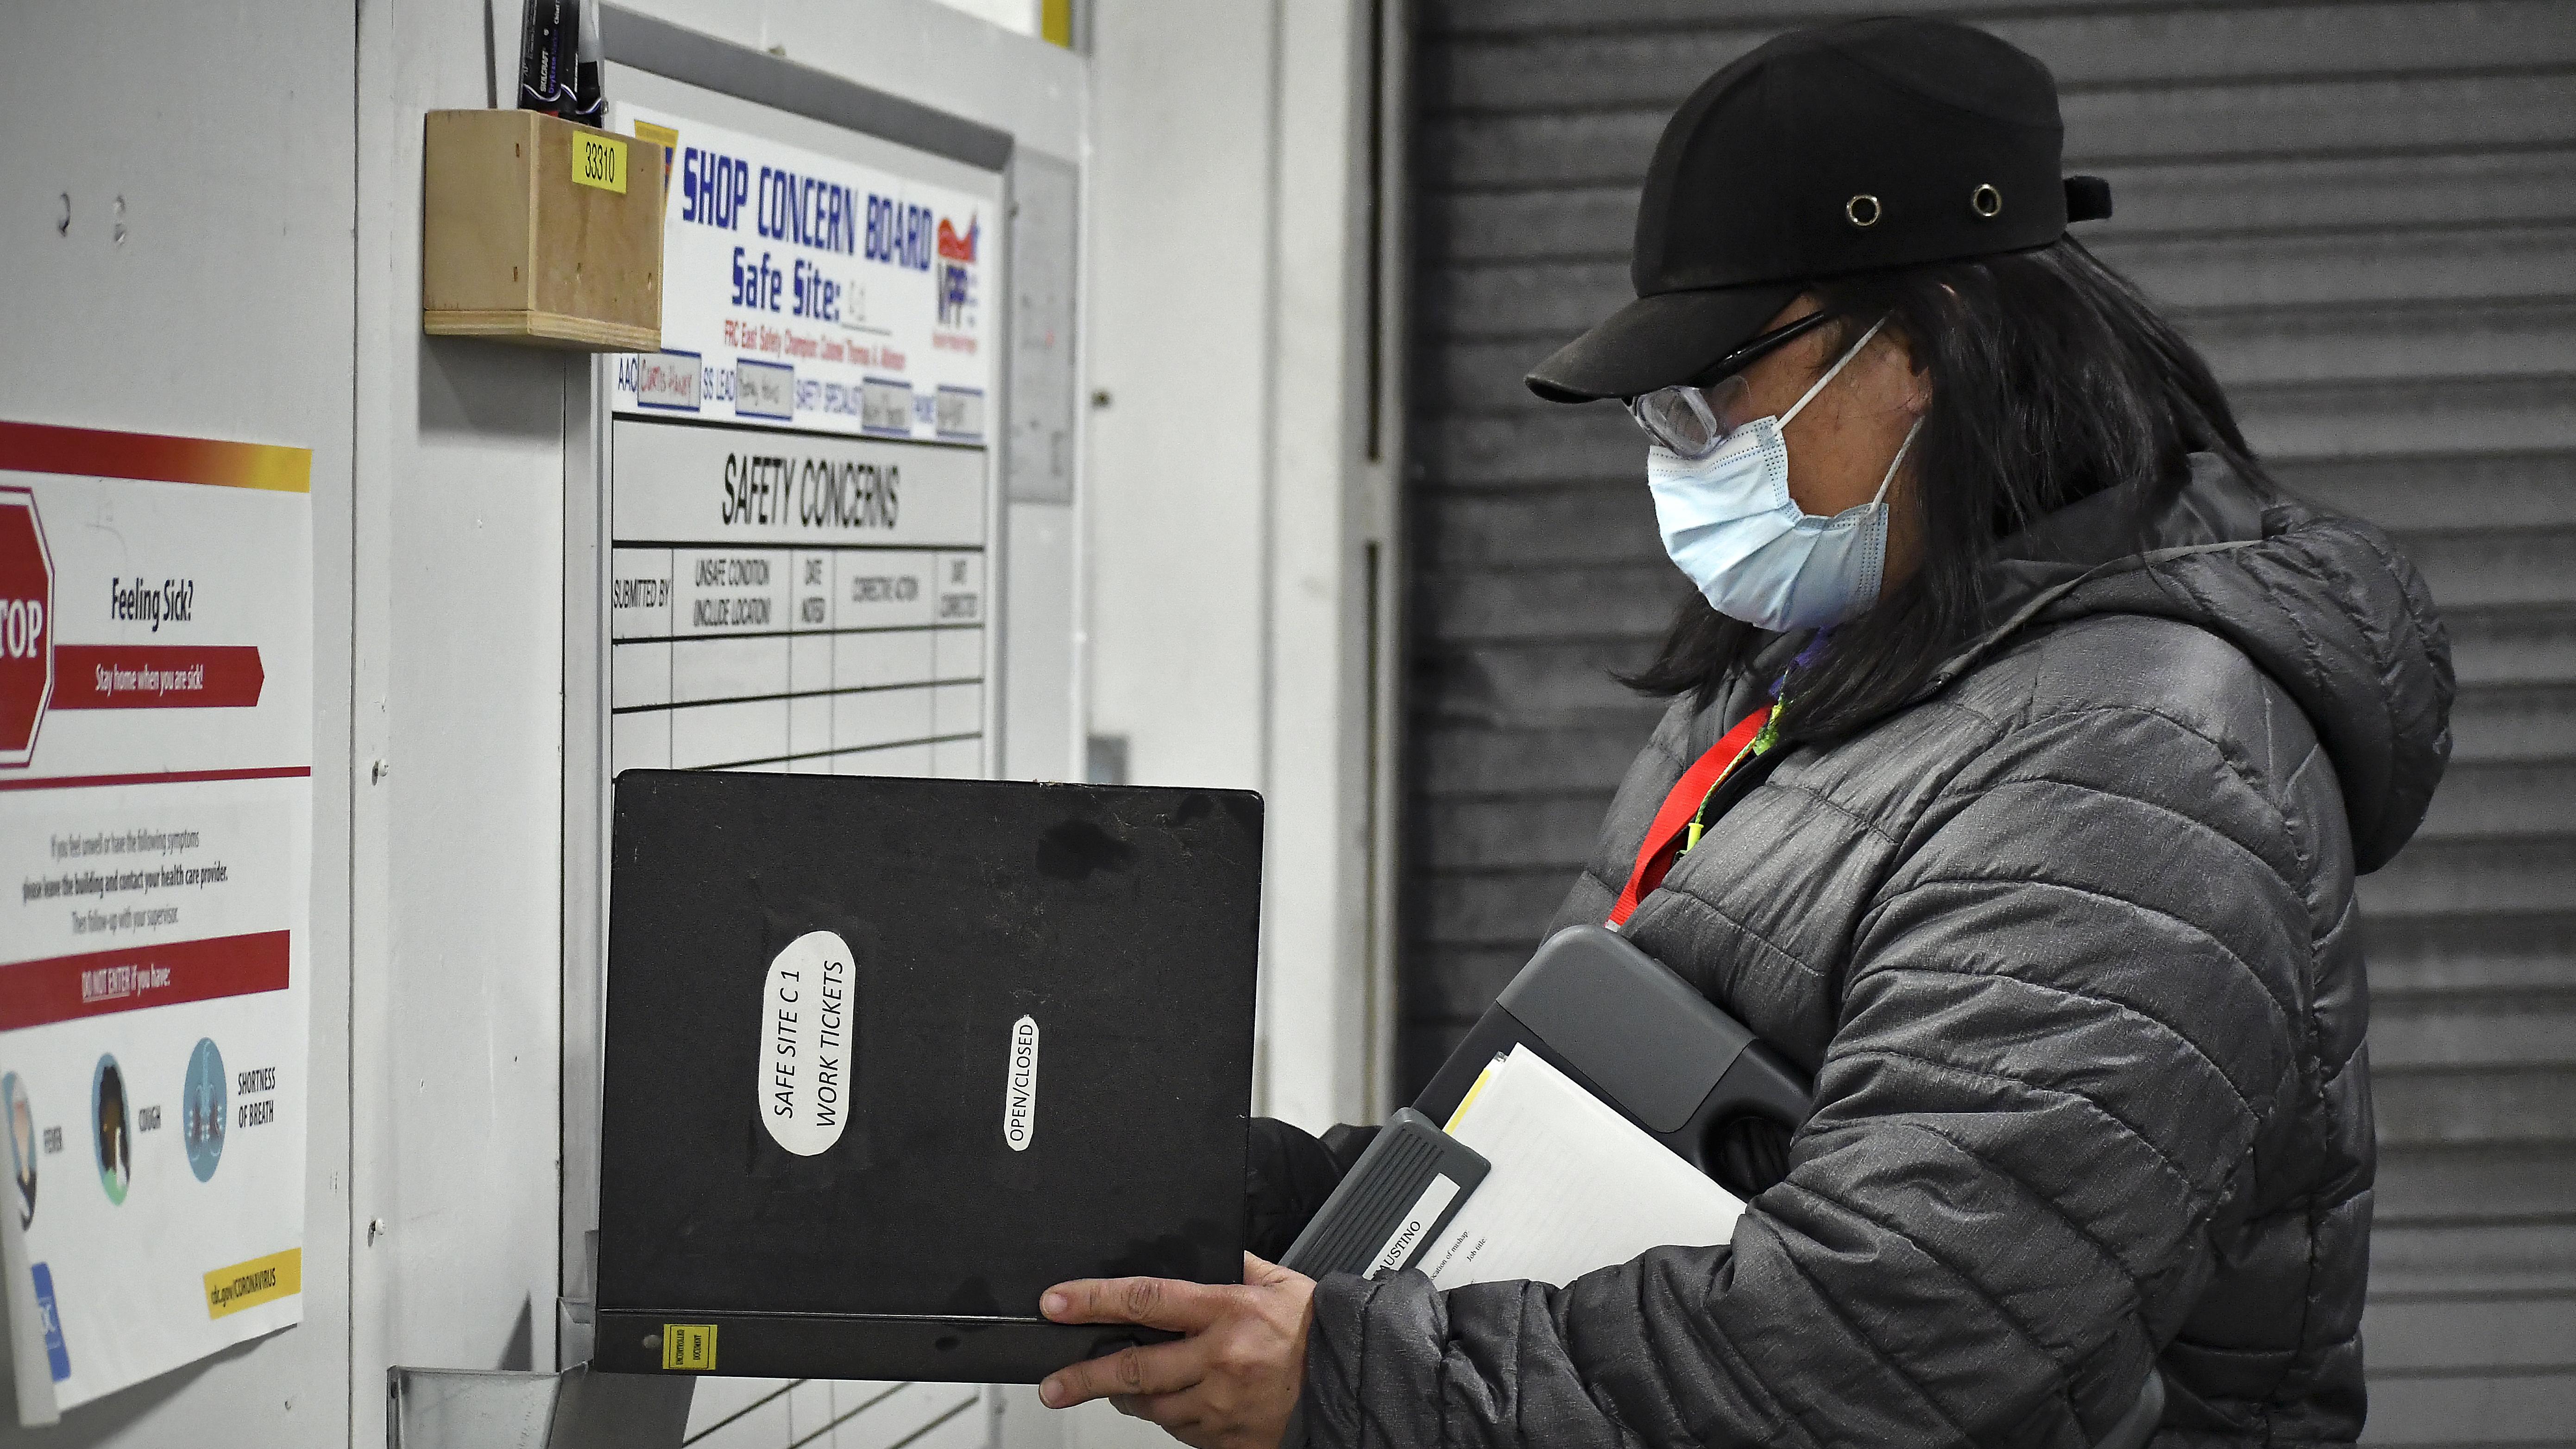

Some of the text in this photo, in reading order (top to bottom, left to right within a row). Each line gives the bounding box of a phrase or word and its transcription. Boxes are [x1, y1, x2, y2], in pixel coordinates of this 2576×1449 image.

[540, 50, 548, 92] SKILCRAFT
[586, 142, 614, 183] 33310
[683, 146, 933, 271] SHOP CONCERN BOARD
[731, 246, 841, 322] Safe Site:
[724, 320, 738, 347] FRC
[742, 321, 757, 349] East
[703, 367, 713, 400] SS
[717, 369, 735, 401] LEAD
[722, 453, 900, 529] SAFETY CONCERNS
[695, 559, 770, 587] UNSAFE CONDITION
[805, 559, 822, 586] DATE
[112, 577, 193, 632] Feeling Sick?
[614, 579, 671, 608] SUBMITTED BY
[95, 663, 204, 697] Stay home when you are sick!
[167, 830, 199, 855] symptoms
[74, 870, 104, 899] building
[105, 869, 118, 892] and
[161, 864, 183, 886] health
[185, 867, 199, 884] care
[199, 861, 228, 889] provider.
[774, 971, 800, 1119] SAFE SITE C 1
[817, 960, 843, 1126] WORK TICKETS
[238, 1067, 275, 1095] SHORTNESS
[1010, 1025, 1033, 1141] OPEN/CLOSED
[139, 1105, 161, 1133] COUGH
[239, 1100, 274, 1128] OF BREATH
[1373, 1221, 1421, 1276] AUSTINO
[1430, 1229, 1469, 1281] ocation of mishap:
[1467, 1237, 1487, 1262] Job title:
[211, 1267, 276, 1307] cdc.gov/CORONAVIRUS
[676, 1329, 685, 1365] UNCONTROLLED
[693, 1335, 702, 1360] DOCUMENT
